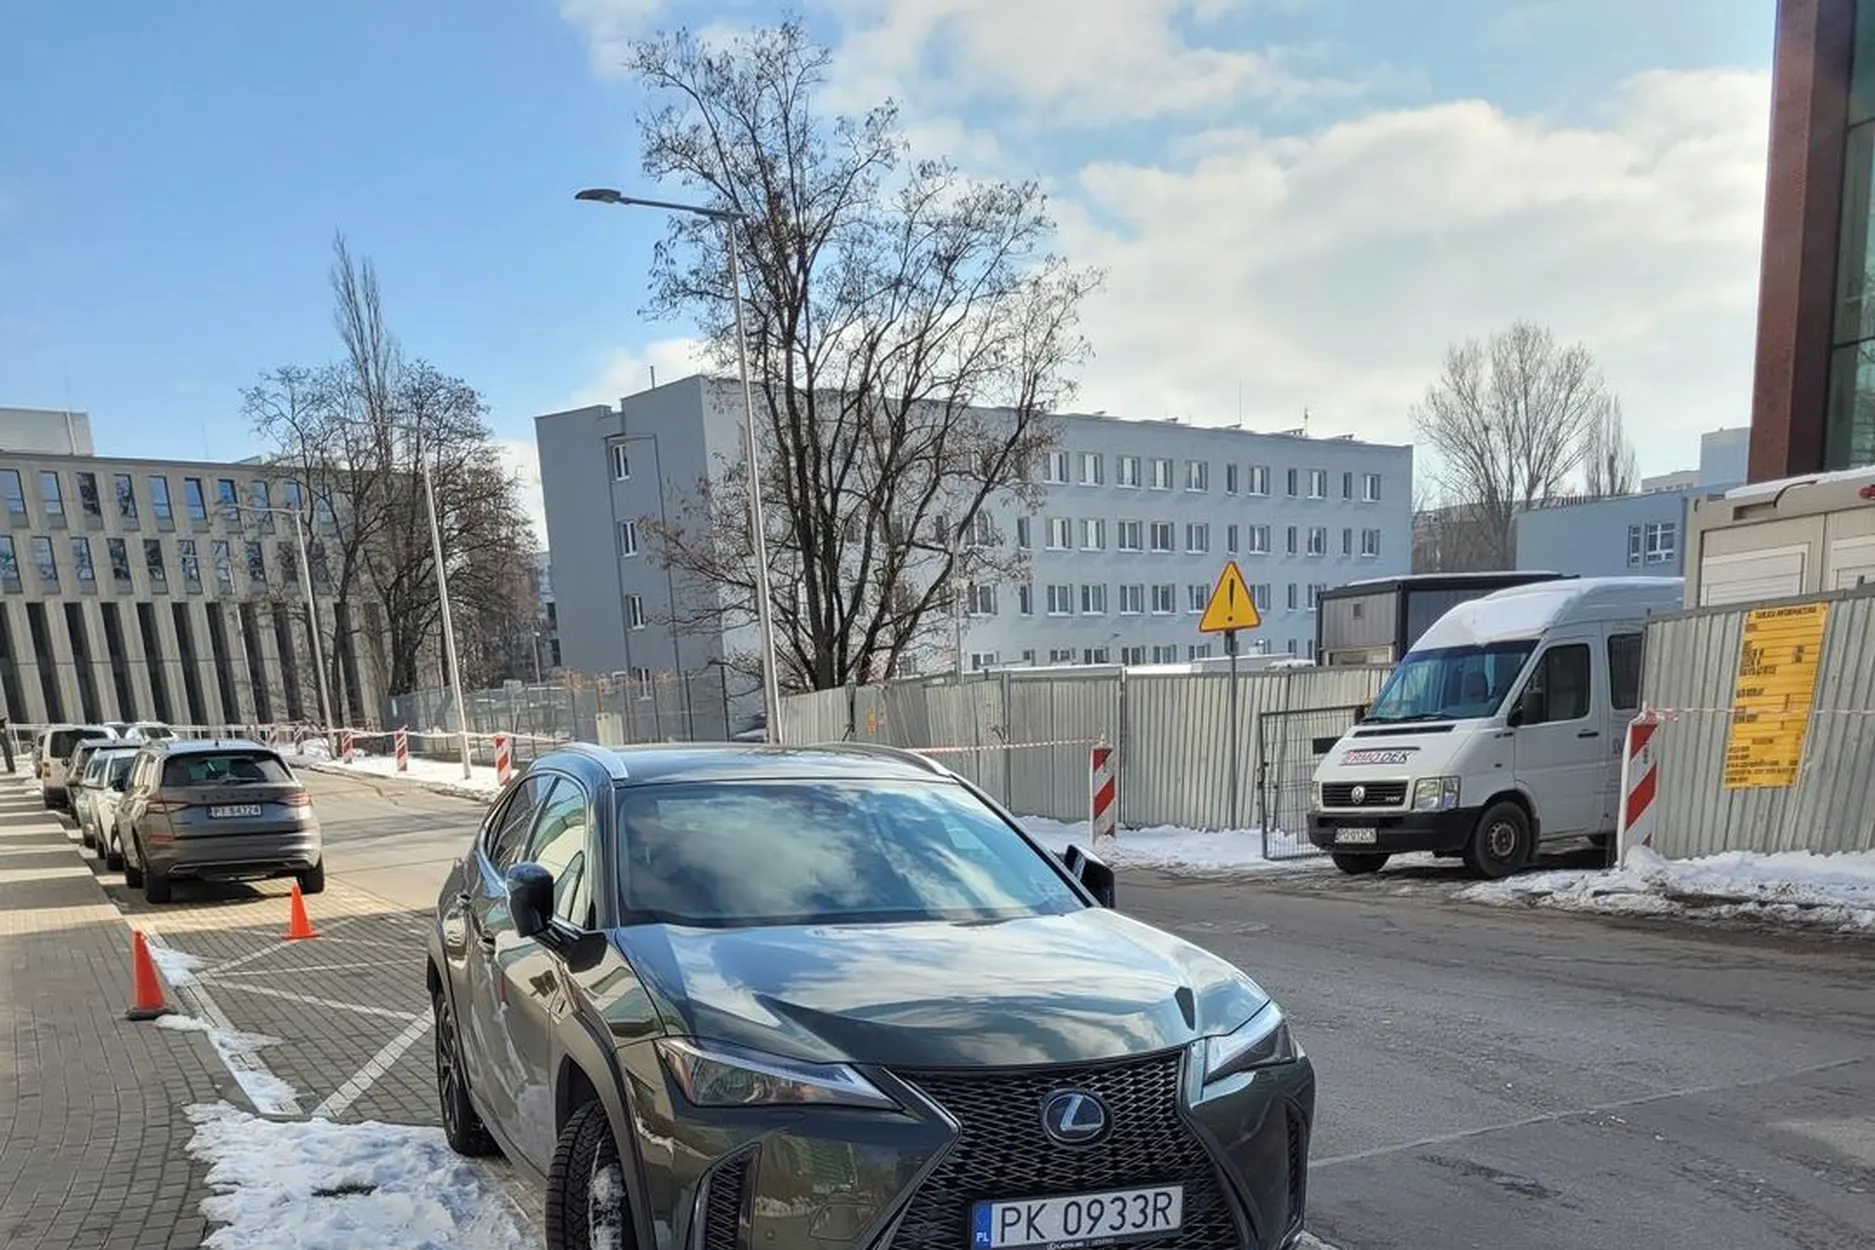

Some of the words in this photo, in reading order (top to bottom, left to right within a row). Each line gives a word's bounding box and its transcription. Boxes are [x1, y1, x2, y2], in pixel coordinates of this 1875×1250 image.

[999, 1203, 1047, 1244] PK
[1062, 1191, 1174, 1237] 0933R
[976, 1232, 989, 1243] PL
